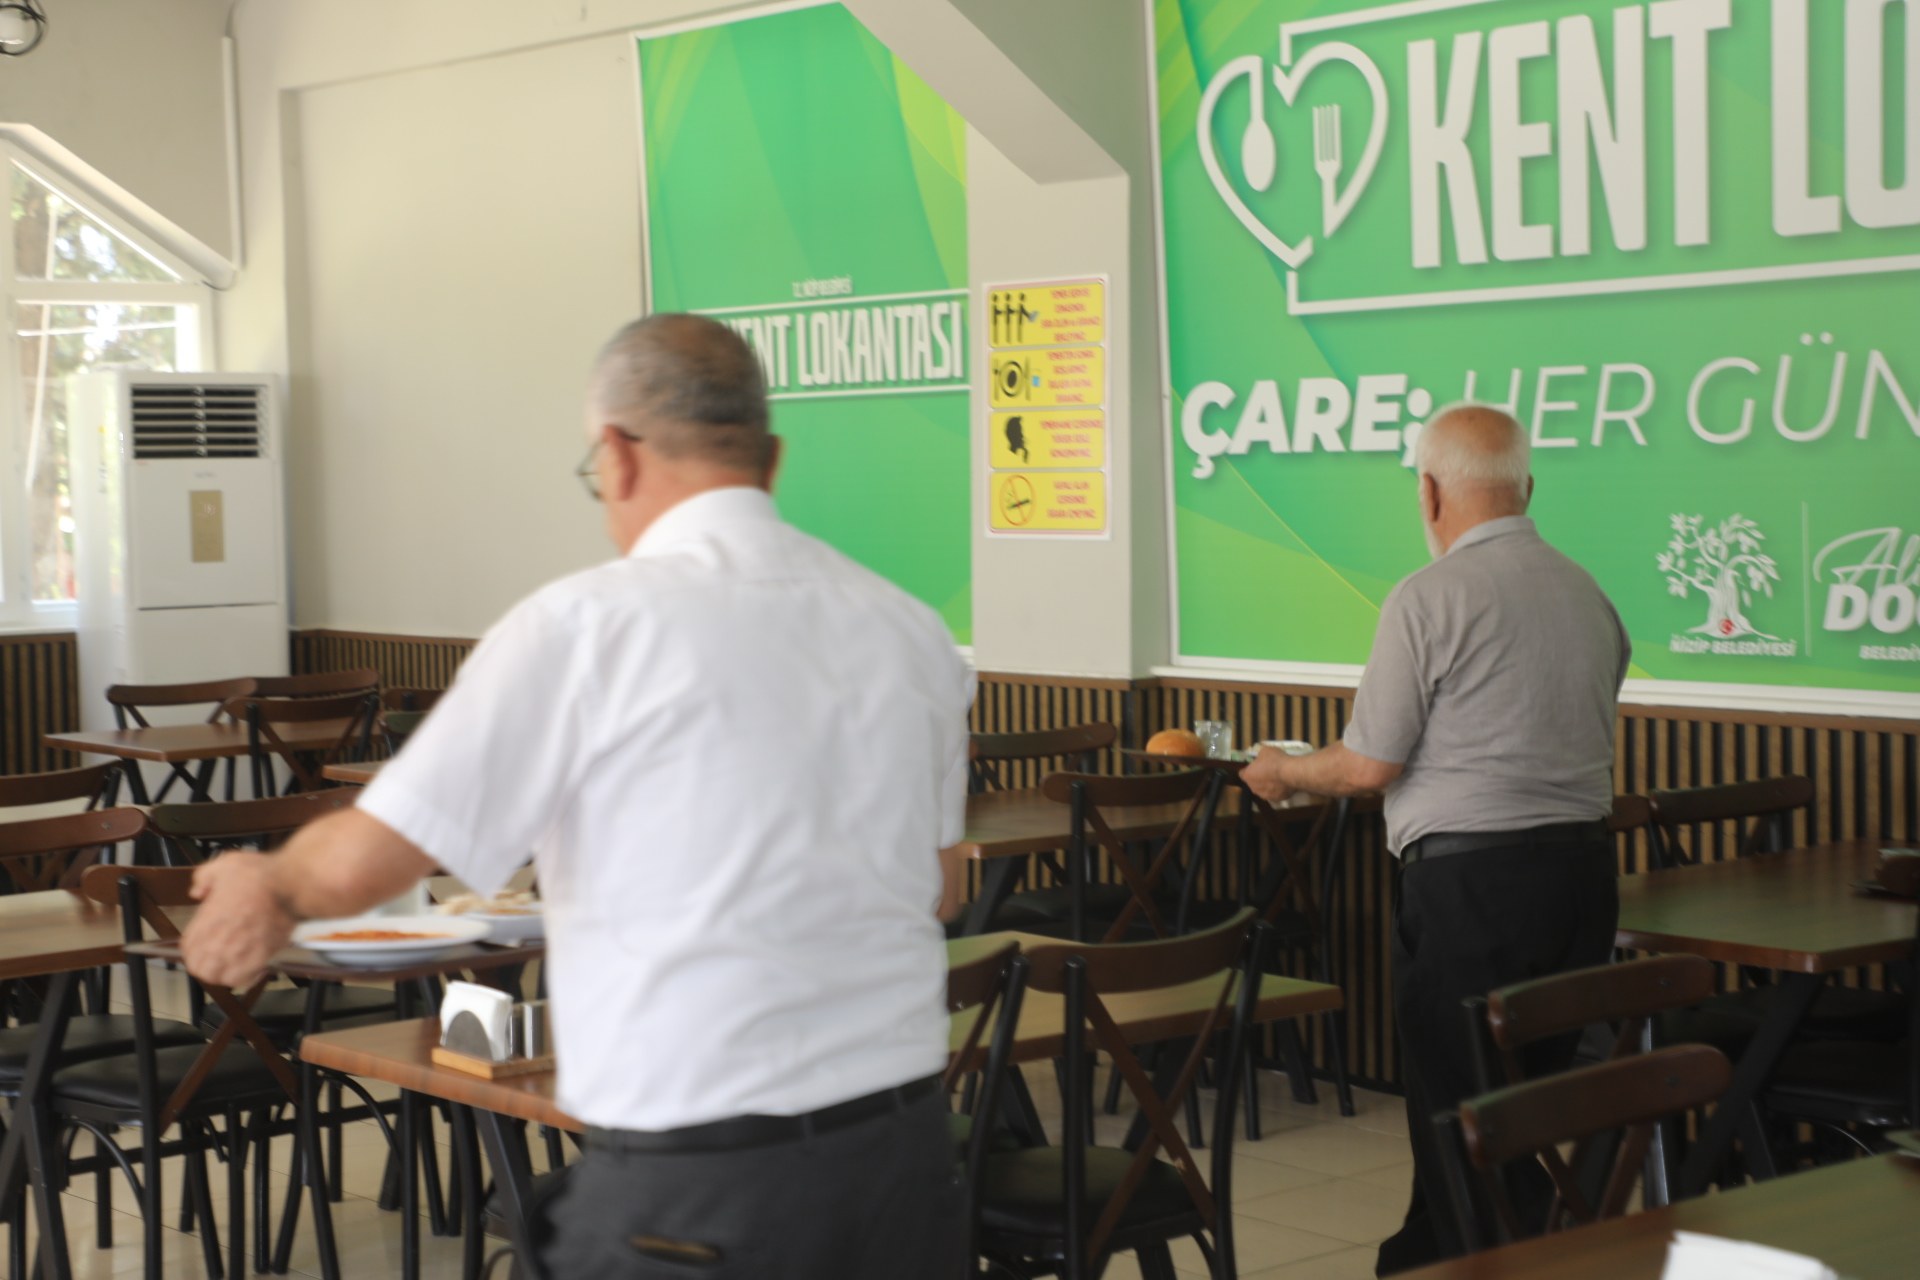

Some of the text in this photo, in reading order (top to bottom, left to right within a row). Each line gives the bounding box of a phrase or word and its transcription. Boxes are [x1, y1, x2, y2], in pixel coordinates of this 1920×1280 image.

[1406, 0, 1732, 269] KENT
[795, 301, 964, 387] LOKANTASI
[1686, 331, 1920, 445] GÜN
